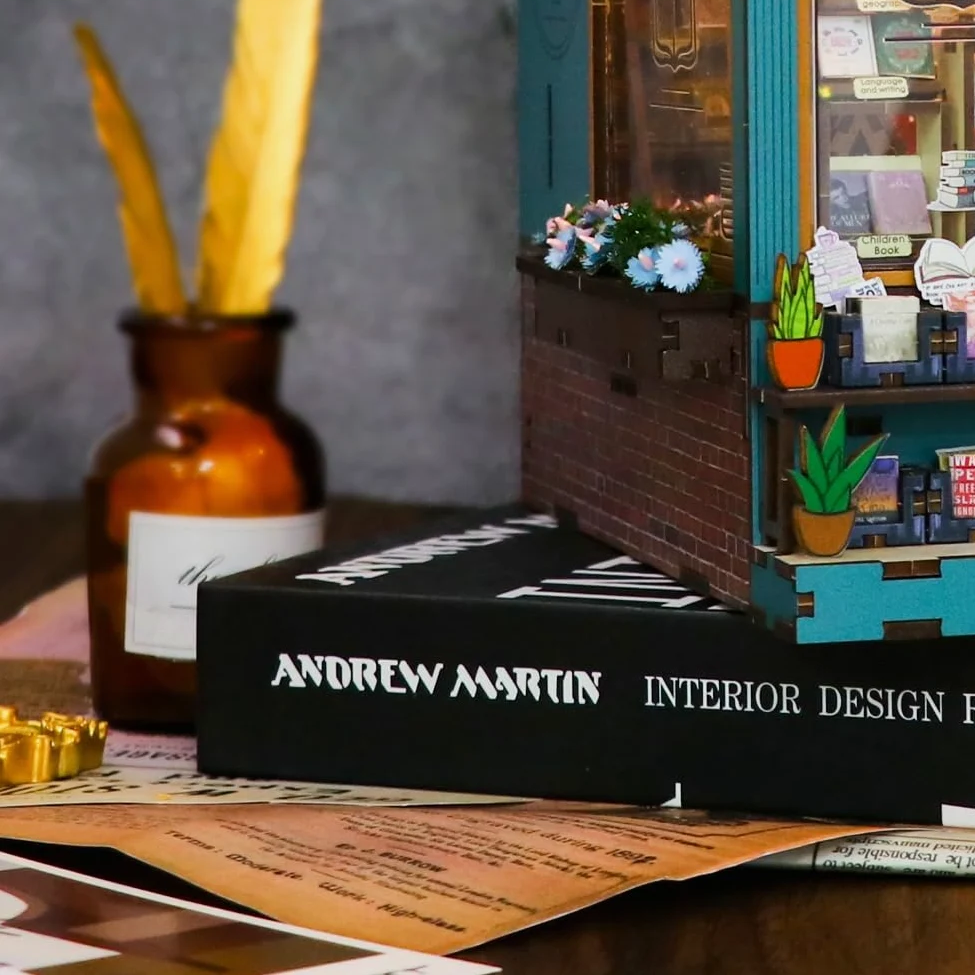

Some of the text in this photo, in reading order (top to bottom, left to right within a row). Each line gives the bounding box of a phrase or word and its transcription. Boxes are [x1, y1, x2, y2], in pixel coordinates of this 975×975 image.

[860, 78, 904, 86] Language
[860, 85, 906, 94] and writing
[874, 246, 900, 255] Book
[271, 653, 443, 695] ANDREW
[450, 663, 602, 705] MARTIN
[643, 675, 802, 715] INTERIOR
[818, 685, 946, 724] DESIGN
[832, 844, 855, 858] for
[857, 846, 938, 863] responsible
[945, 854, 963, 869] be
